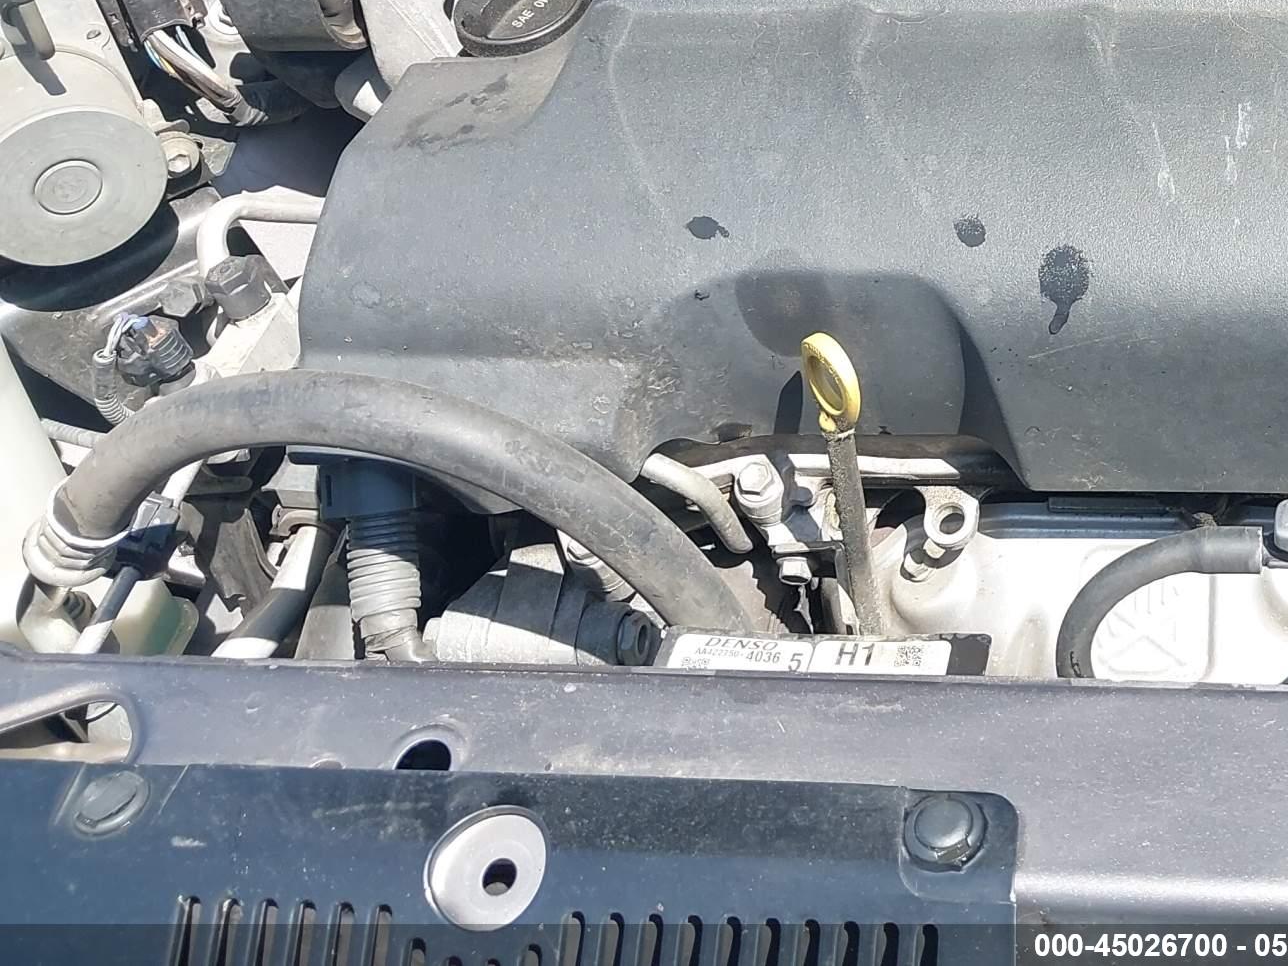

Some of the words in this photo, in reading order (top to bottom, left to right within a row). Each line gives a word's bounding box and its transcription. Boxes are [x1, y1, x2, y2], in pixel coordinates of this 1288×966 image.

[512, 10, 535, 28] SAE
[705, 637, 778, 651] DENSO
[788, 652, 804, 672] 5
[835, 642, 875, 667] H1
